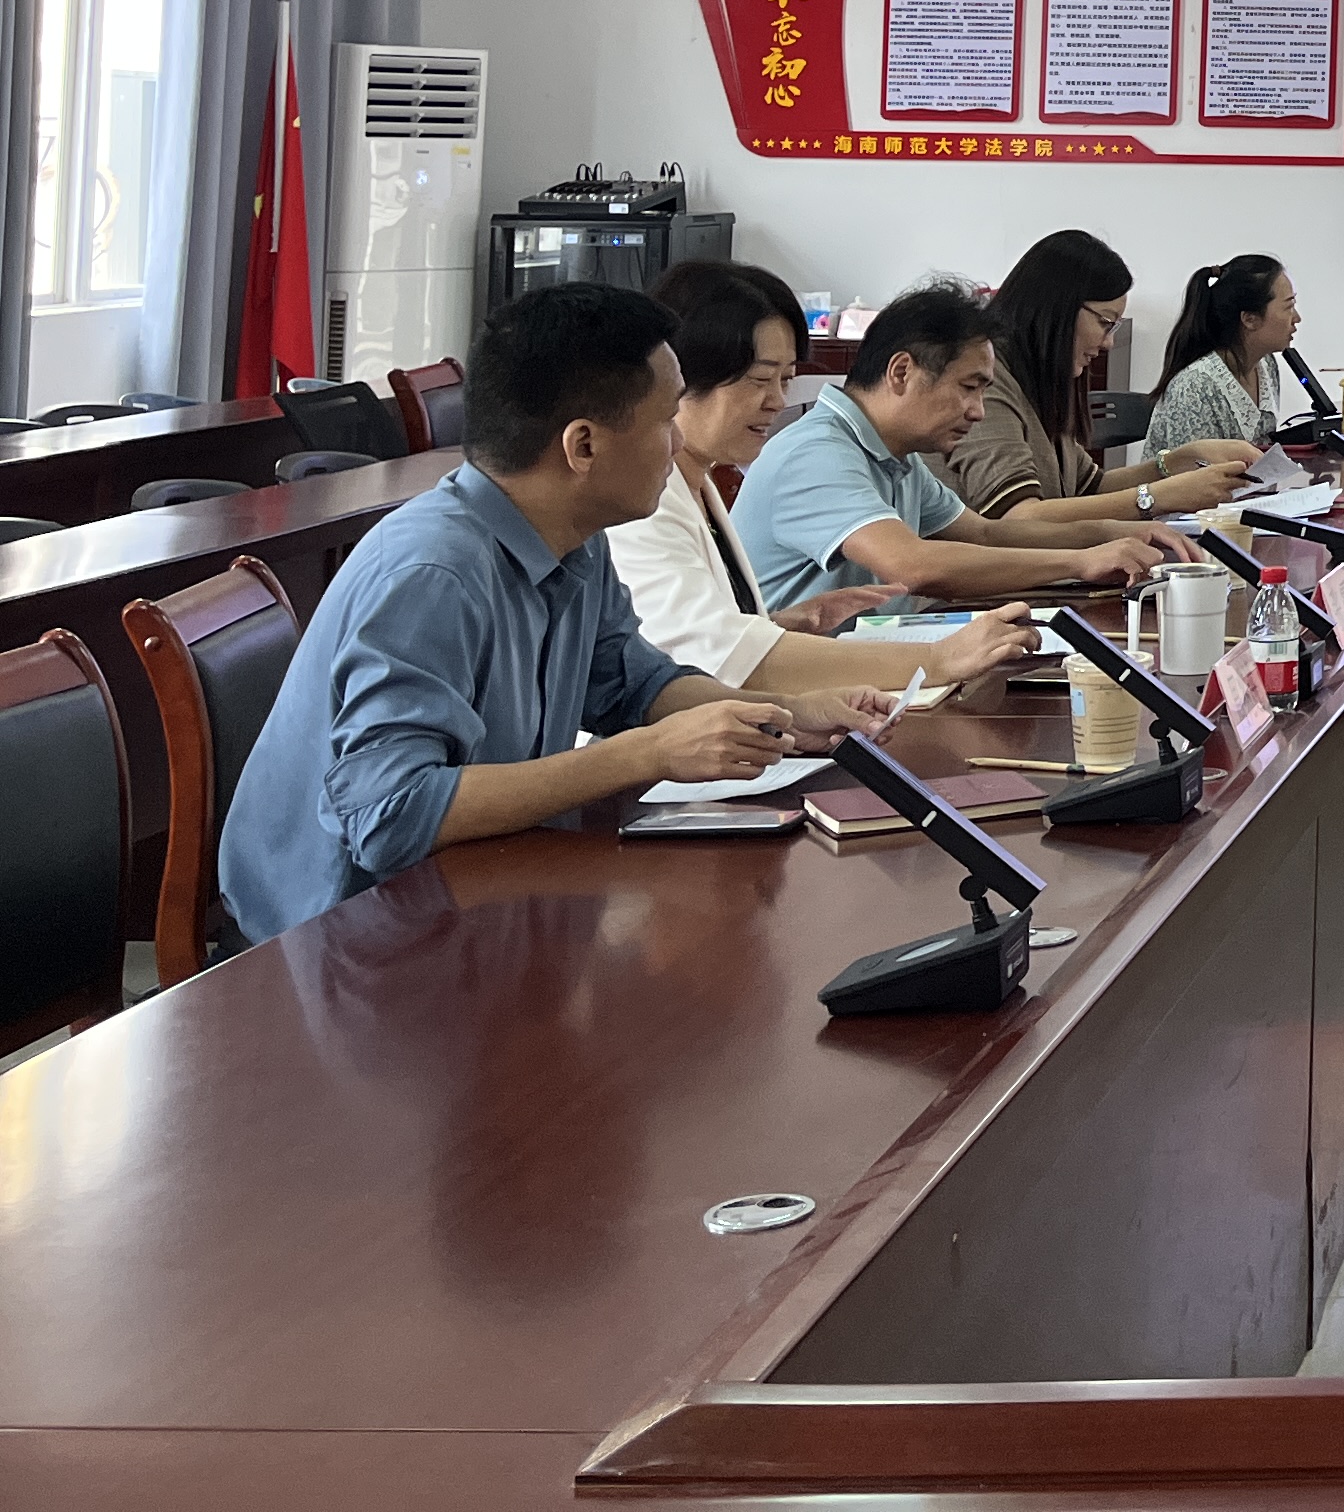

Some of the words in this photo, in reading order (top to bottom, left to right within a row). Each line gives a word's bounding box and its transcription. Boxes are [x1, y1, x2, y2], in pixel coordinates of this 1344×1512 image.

[833, 134, 1054, 157] 海南师范大学法学院
